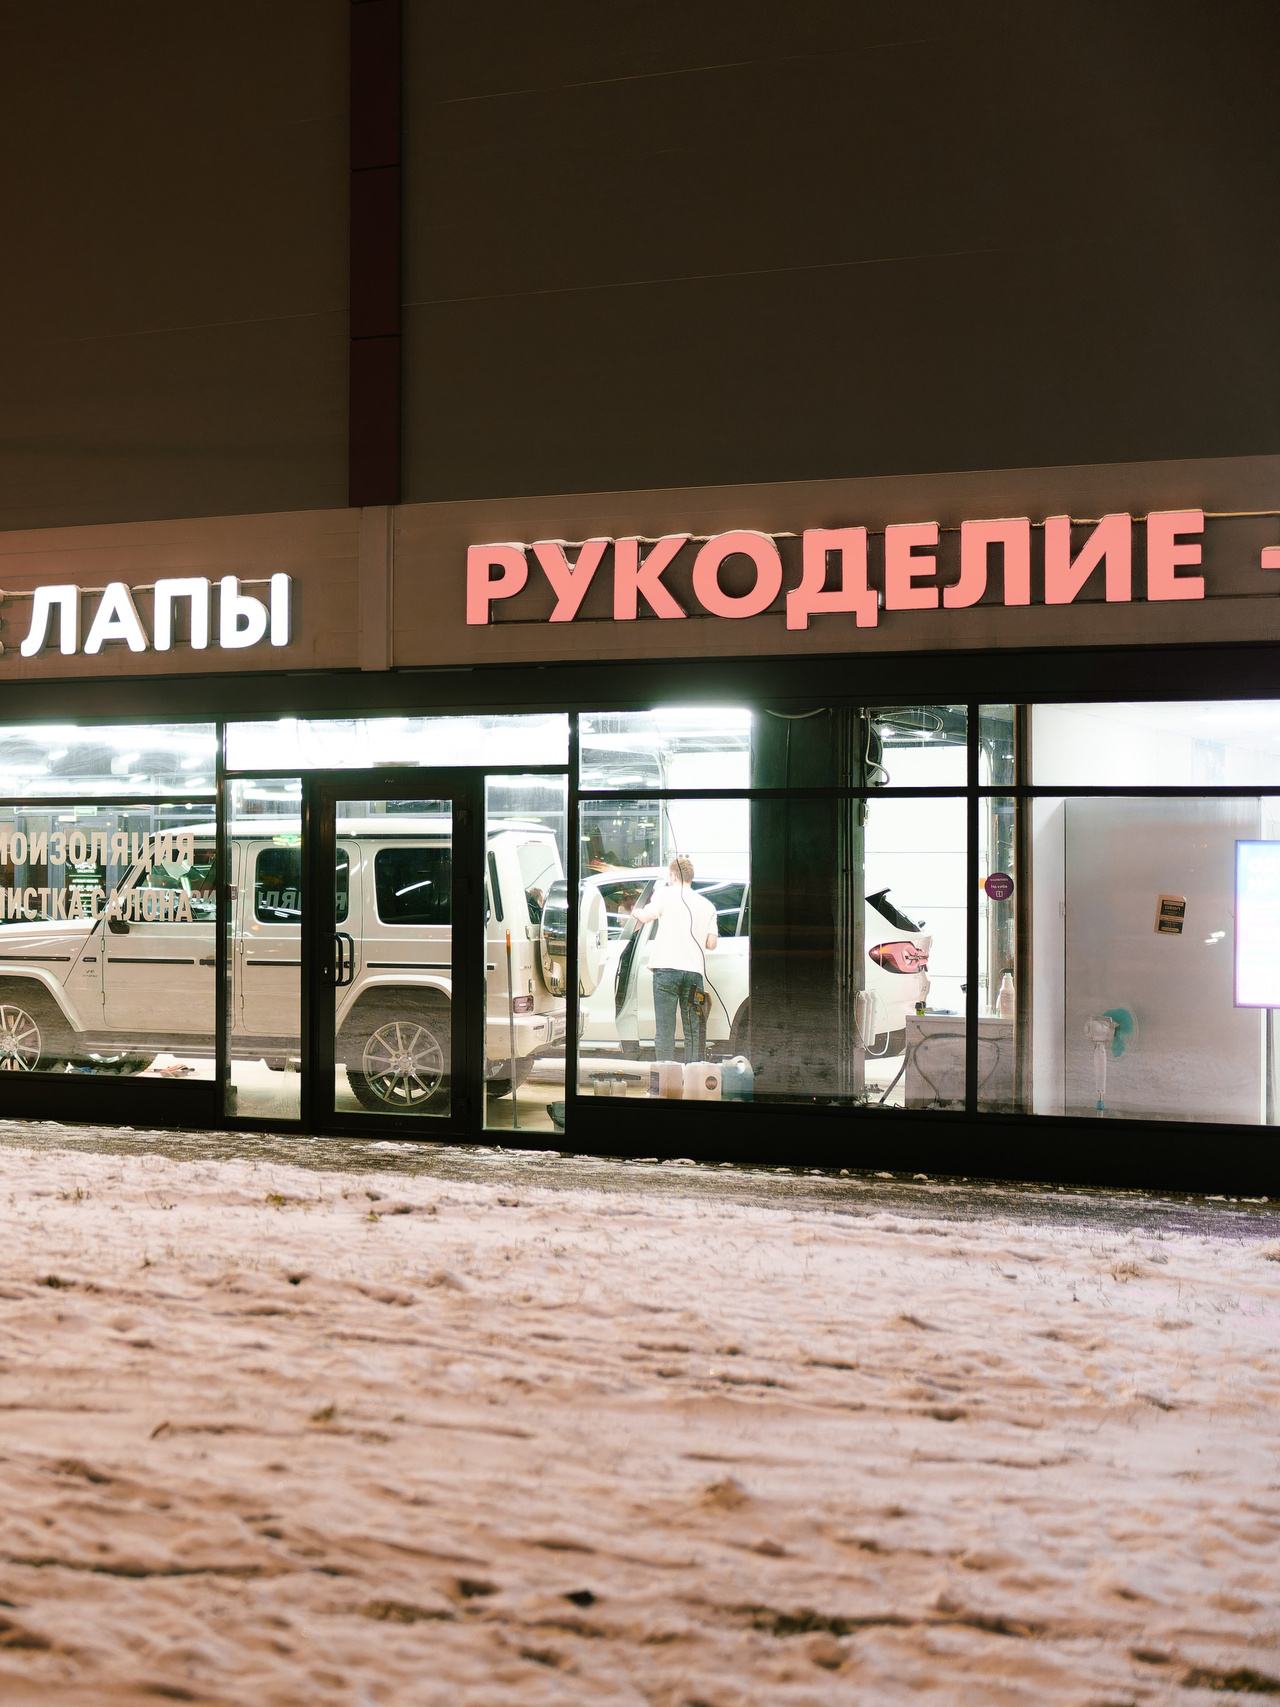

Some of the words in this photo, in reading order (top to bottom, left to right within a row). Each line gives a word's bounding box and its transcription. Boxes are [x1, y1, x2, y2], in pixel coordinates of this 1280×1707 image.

[465, 509, 1206, 631] РУКОДЕЛИЕ
[20, 572, 294, 658] ЛАПЫ
[90, 887, 194, 923] САЛОНА
